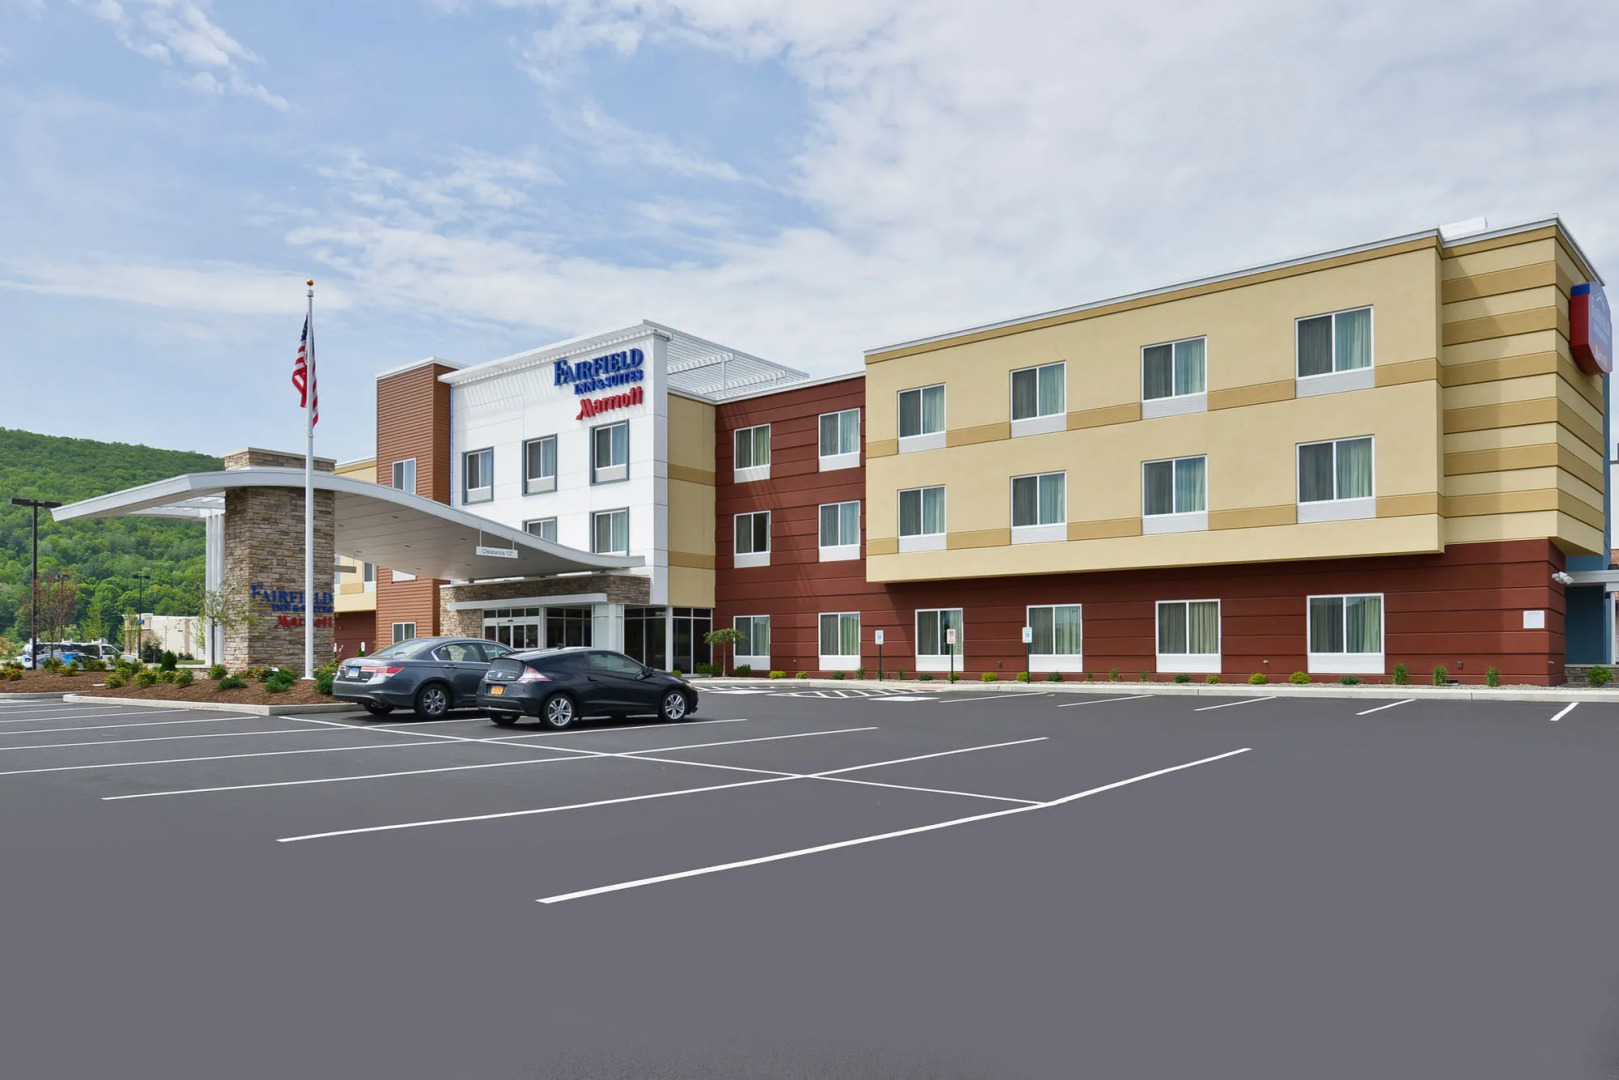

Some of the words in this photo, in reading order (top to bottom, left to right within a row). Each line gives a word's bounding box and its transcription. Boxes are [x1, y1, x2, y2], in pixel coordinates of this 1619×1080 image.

[553, 348, 644, 386] FAIRFIELD
[574, 378, 596, 395] INN
[605, 369, 644, 388] SUITES
[576, 386, 643, 420] Marriott
[252, 583, 334, 604] FAIRFILD
[274, 615, 333, 628] Marott
